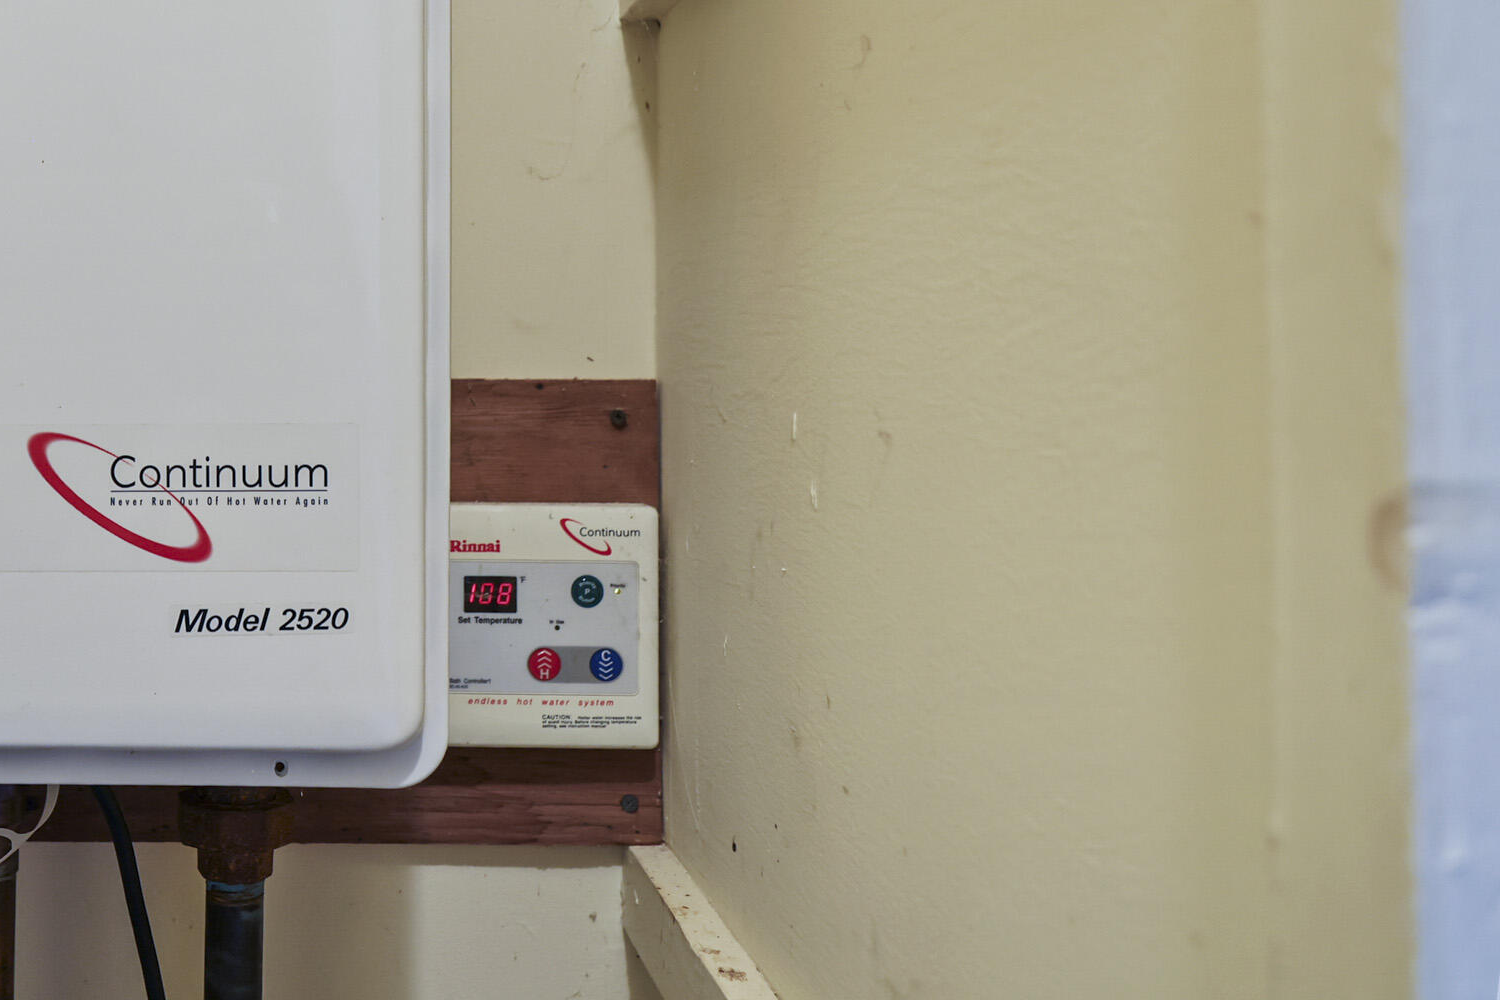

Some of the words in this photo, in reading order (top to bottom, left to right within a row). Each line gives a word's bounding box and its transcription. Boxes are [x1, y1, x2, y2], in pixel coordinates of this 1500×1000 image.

[109, 453, 328, 490] Continuum
[110, 496, 142, 506] Never
[151, 496, 172, 506] Run
[180, 496, 199, 506] Out
[206, 495, 218, 506] Of
[226, 496, 245, 506] Hot
[253, 496, 287, 505] Water
[295, 496, 328, 507] Again
[579, 526, 640, 537] Continuum
[450, 539, 501, 553] Rinnai
[469, 582, 513, 605] 108
[174, 607, 270, 633] Model
[278, 607, 349, 631] 2520
[473, 616, 522, 625] Temperature
[601, 650, 611, 662] C
[540, 669, 549, 680] H
[467, 697, 507, 705] endless
[578, 699, 614, 707] system
